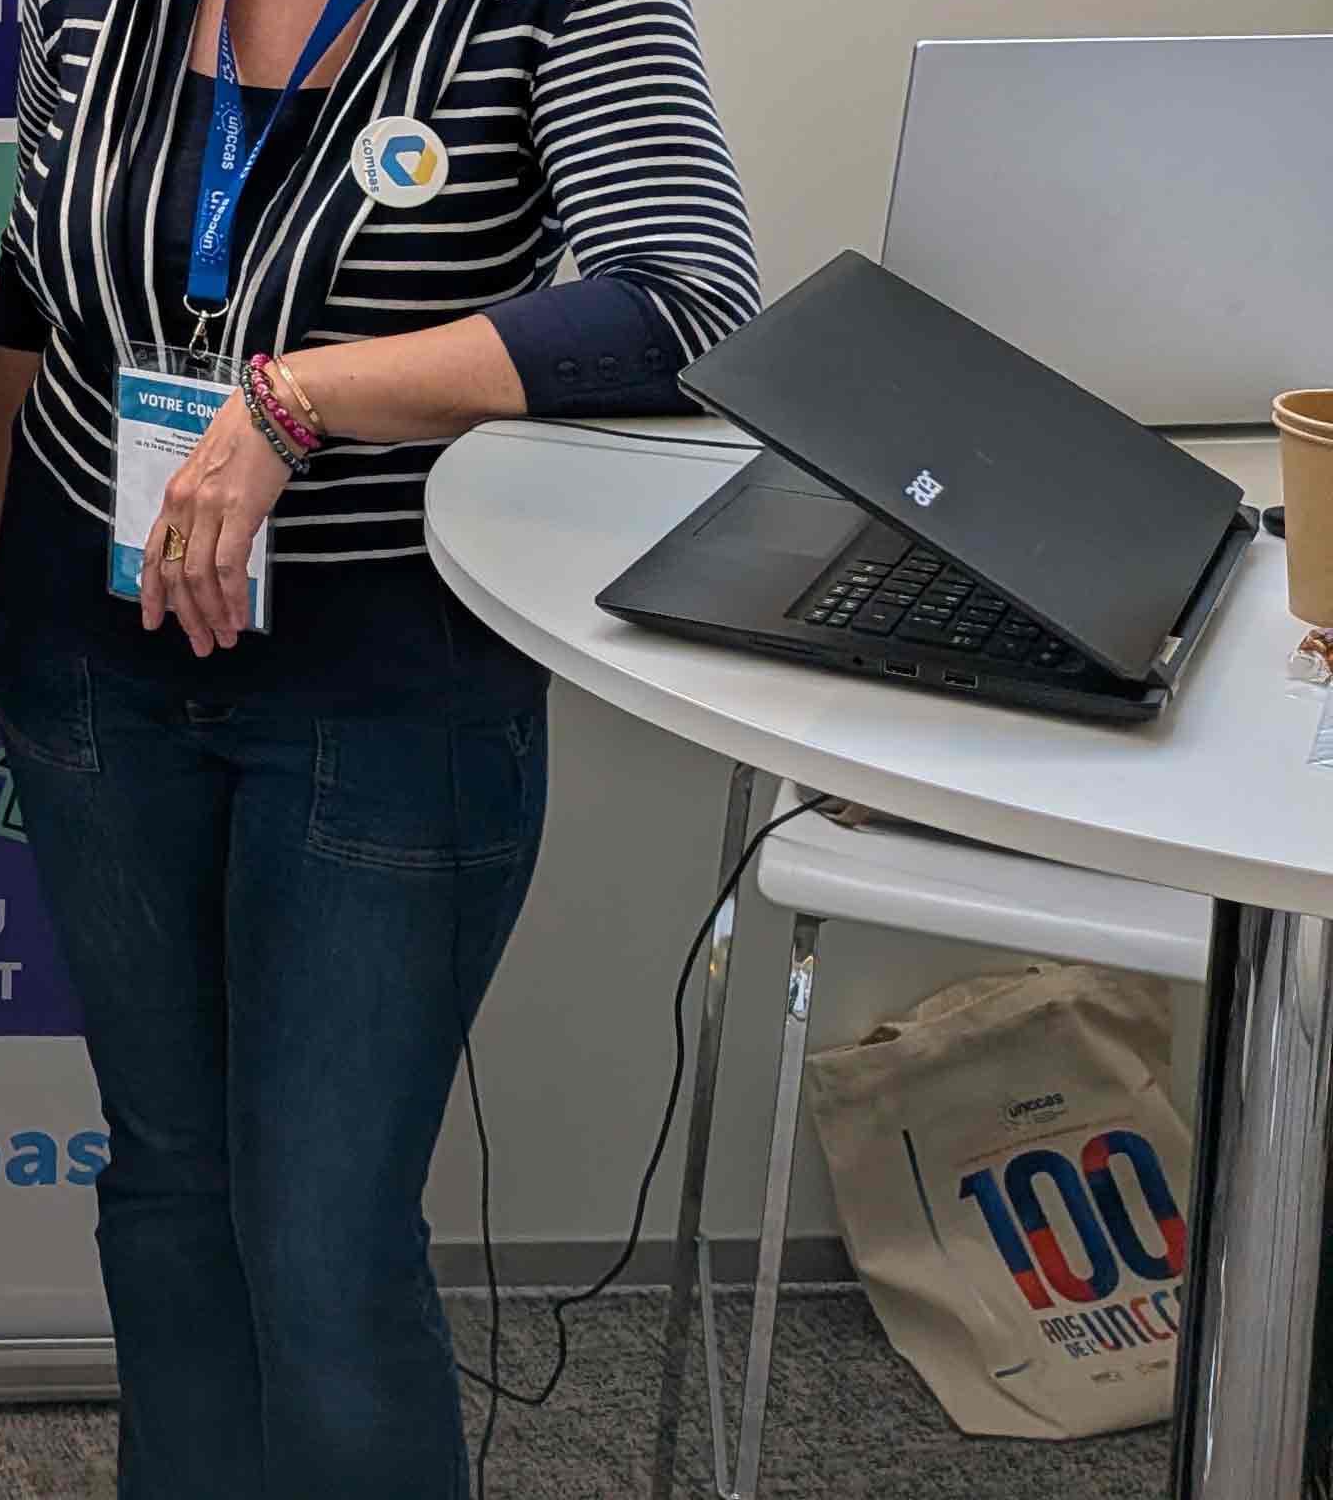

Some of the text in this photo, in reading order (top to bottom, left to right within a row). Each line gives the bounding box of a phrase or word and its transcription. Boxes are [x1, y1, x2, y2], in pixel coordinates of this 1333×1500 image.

[221, 115, 238, 171] unccas
[362, 137, 381, 194] compas
[138, 391, 221, 419] VOTRE CON
[1008, 1092, 1065, 1119] unccas
[959, 1130, 1189, 1311] 100
[1040, 1314, 1086, 1346] ANS
[1079, 1285, 1183, 1352] UNCC
